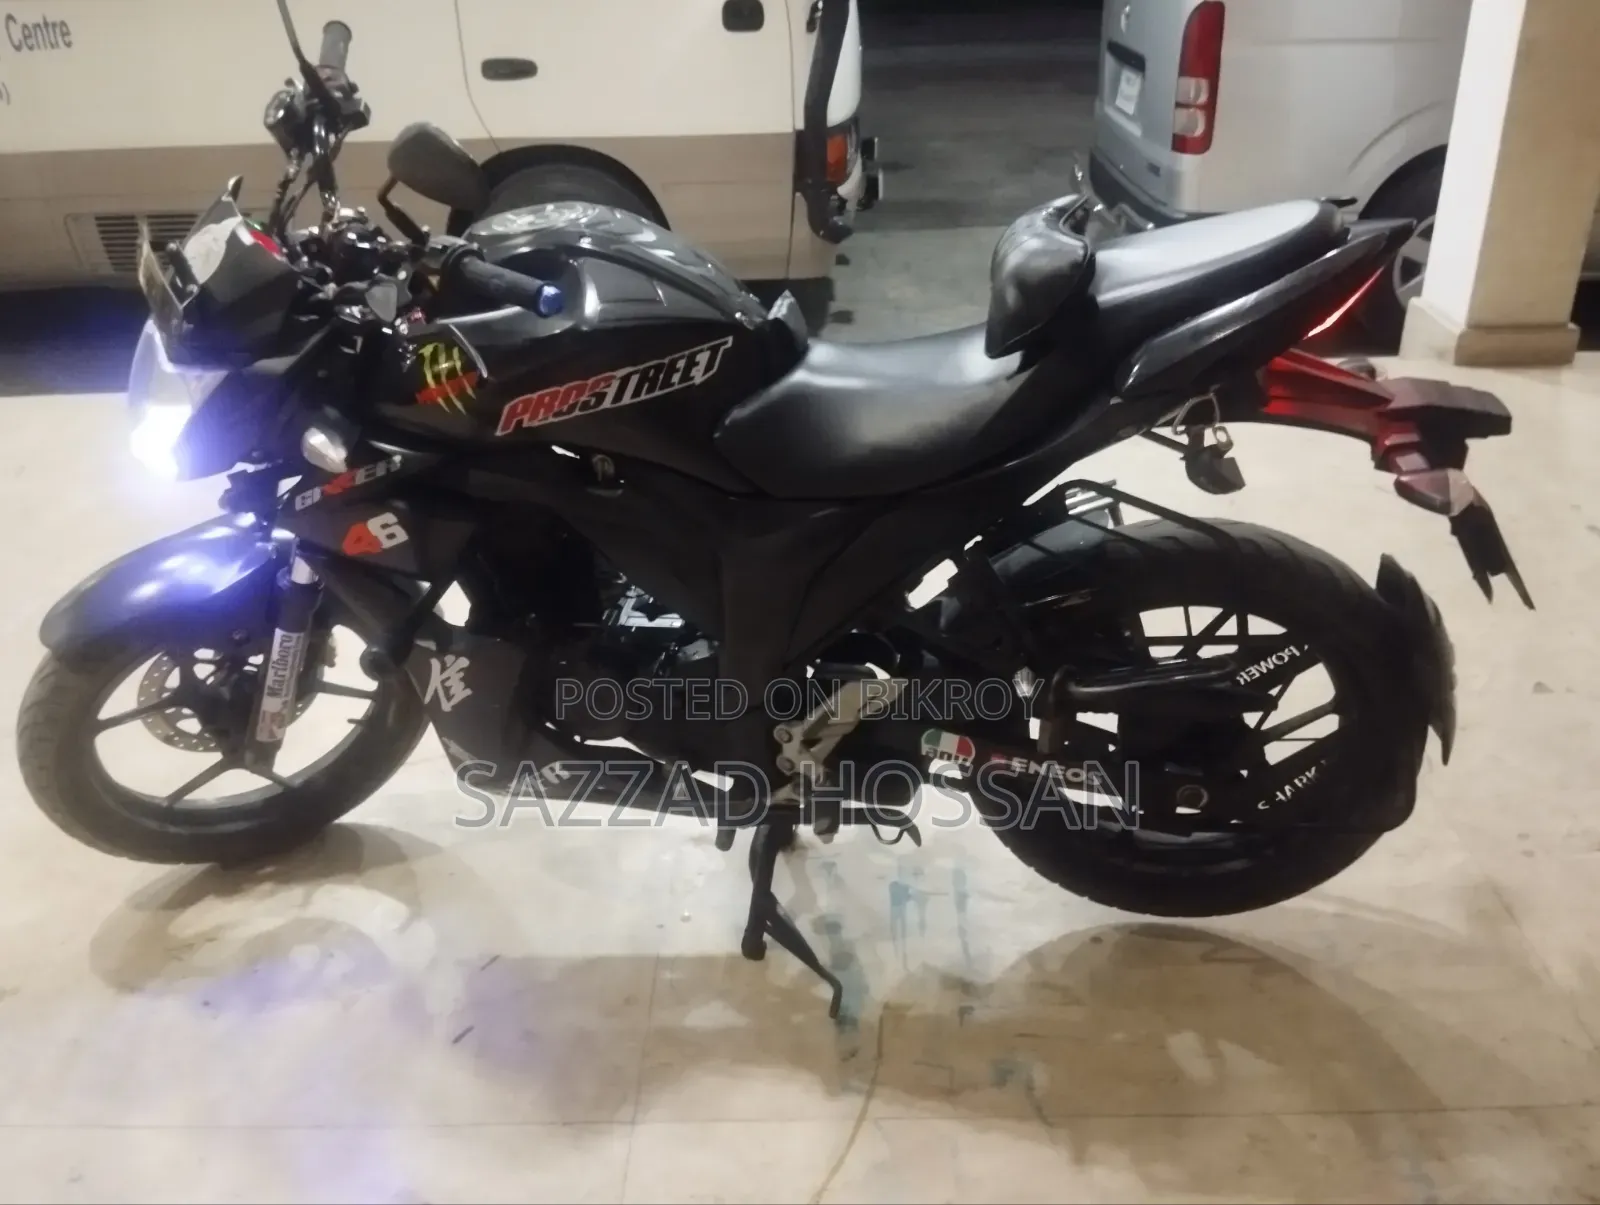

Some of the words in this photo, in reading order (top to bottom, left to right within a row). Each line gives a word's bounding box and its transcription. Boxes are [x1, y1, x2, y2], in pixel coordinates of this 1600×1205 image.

[5, 13, 73, 52] Centre
[494, 335, 734, 437] PROSTREET
[343, 511, 409, 556] 46
[266, 633, 295, 699] Marlboro
[1010, 756, 1104, 786] ENEOS
